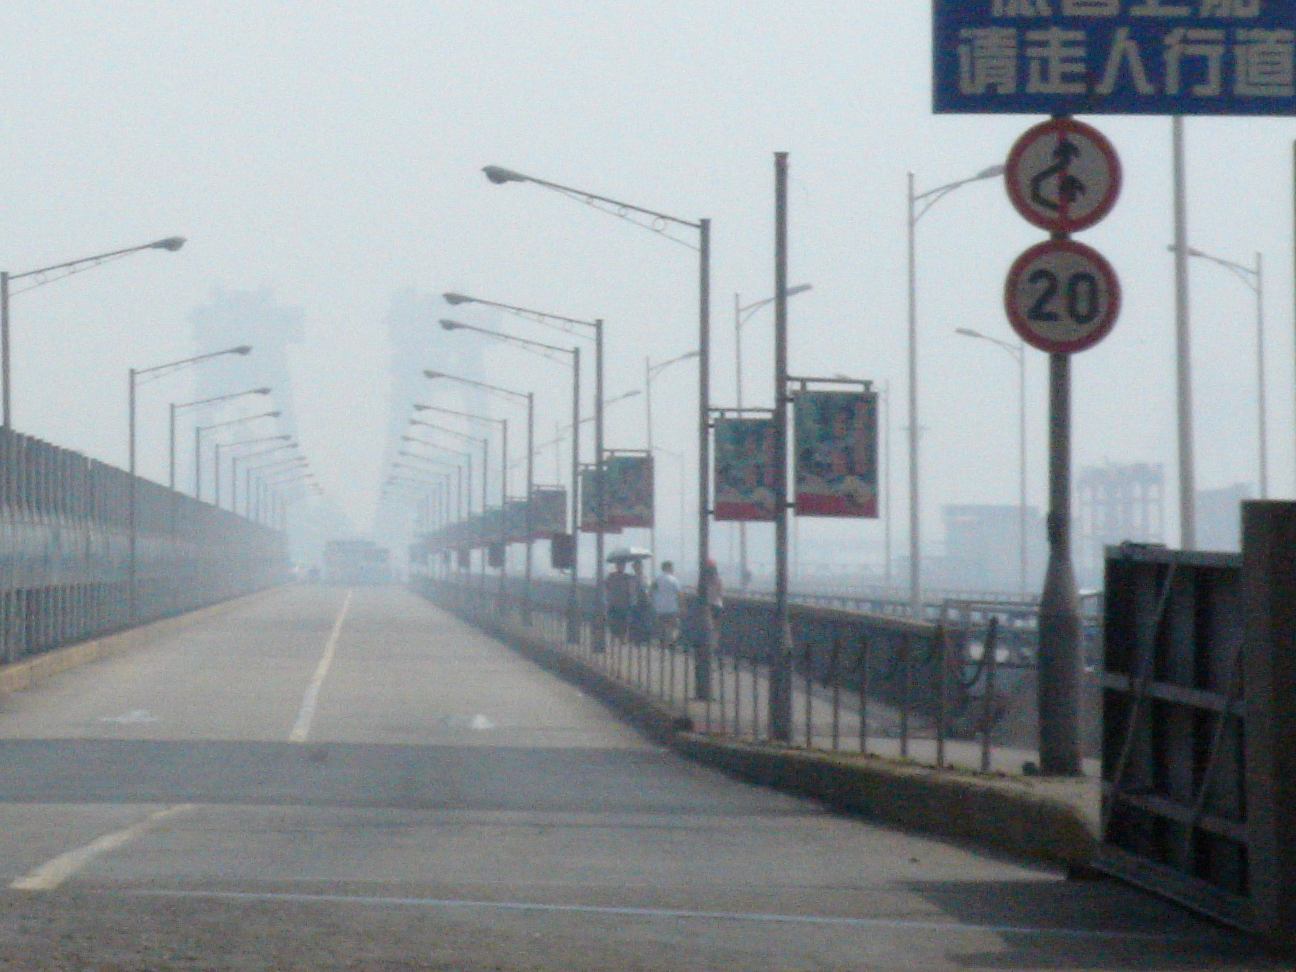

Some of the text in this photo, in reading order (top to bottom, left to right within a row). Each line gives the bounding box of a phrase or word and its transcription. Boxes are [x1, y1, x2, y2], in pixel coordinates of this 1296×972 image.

[957, 26, 1295, 97] 请走人行道
[1027, 268, 1100, 324] 20
